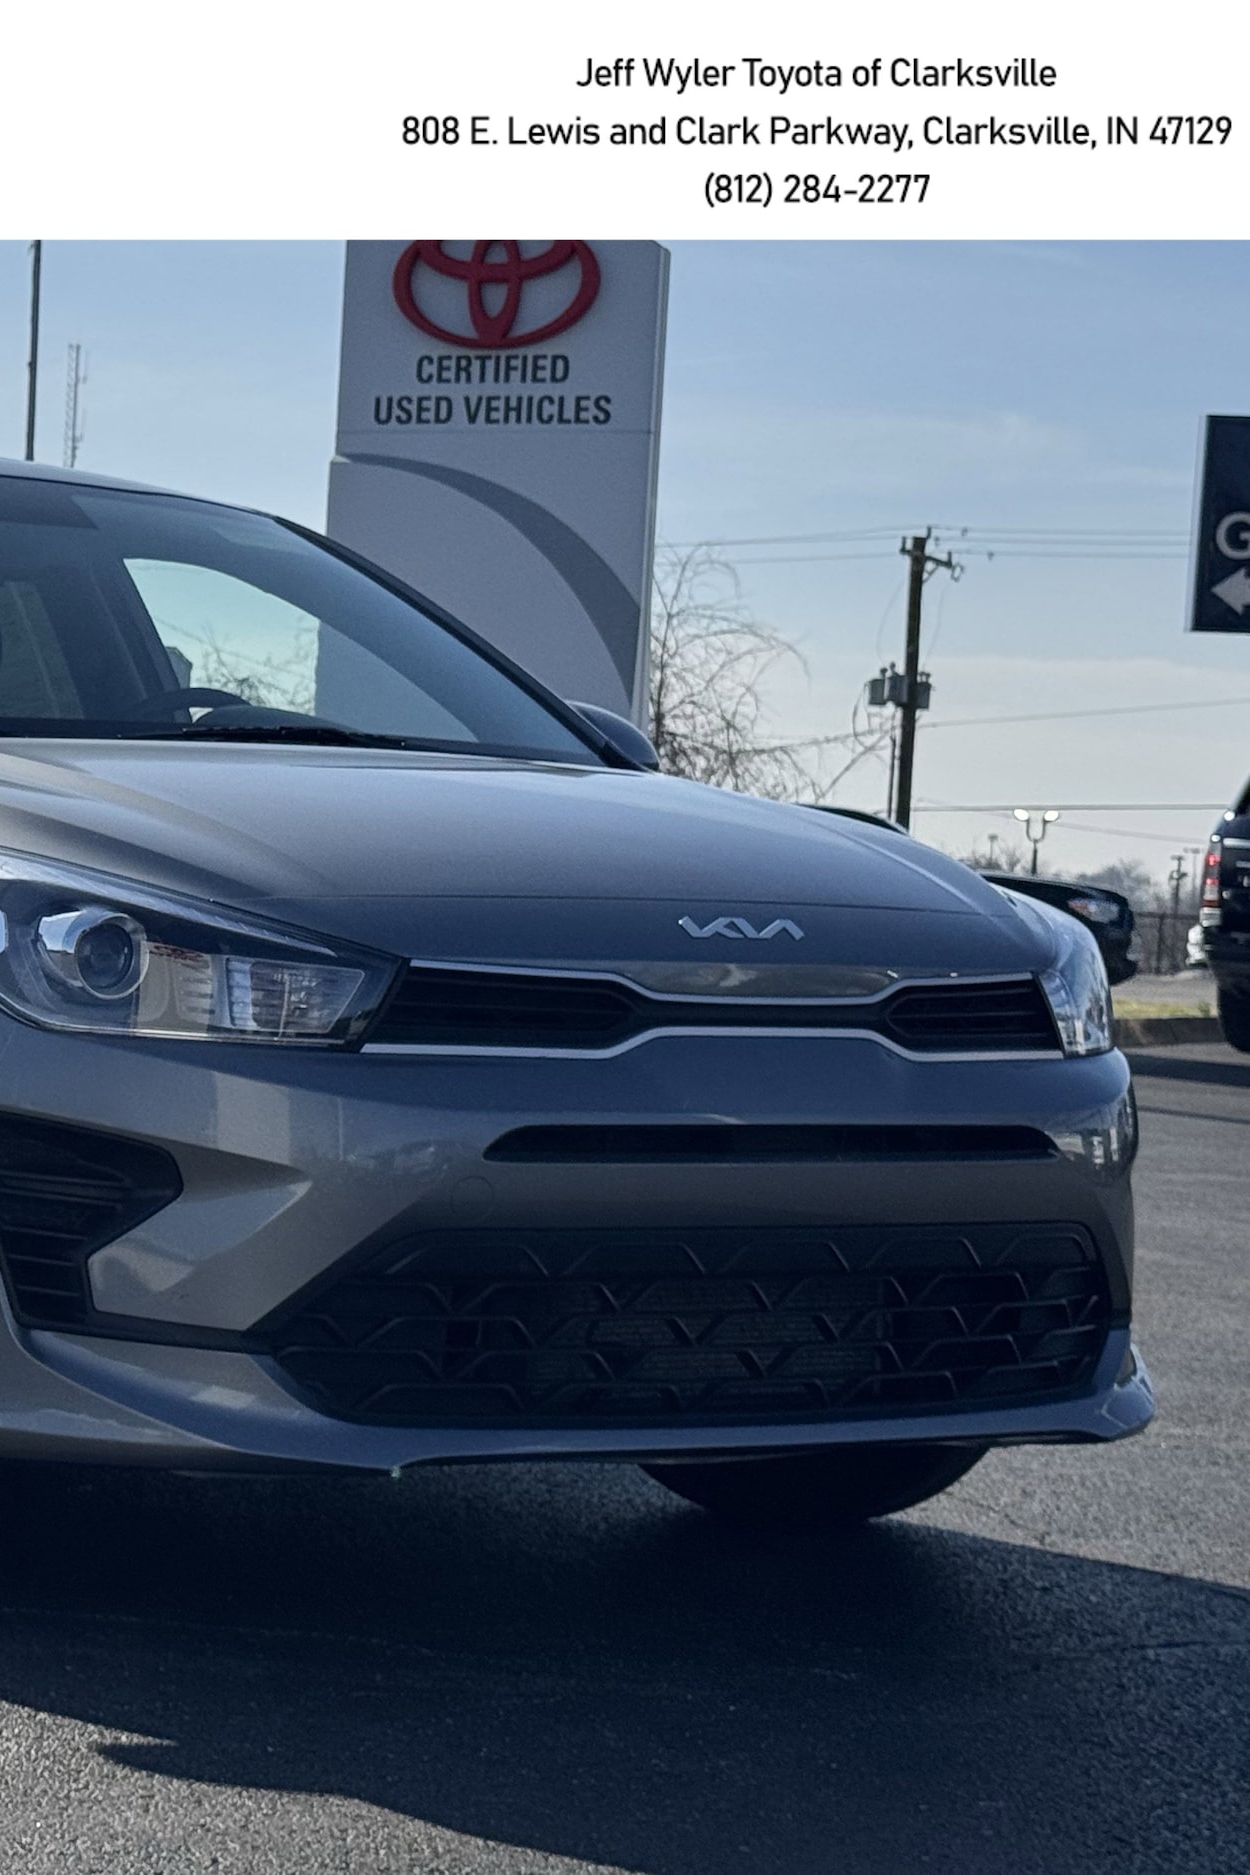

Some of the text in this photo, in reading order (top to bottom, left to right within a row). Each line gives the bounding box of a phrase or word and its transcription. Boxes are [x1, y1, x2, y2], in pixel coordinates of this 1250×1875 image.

[415, 353, 571, 385] CERTIFIED
[373, 395, 612, 426] USED VEHICLES
[677, 915, 806, 942] KIA
